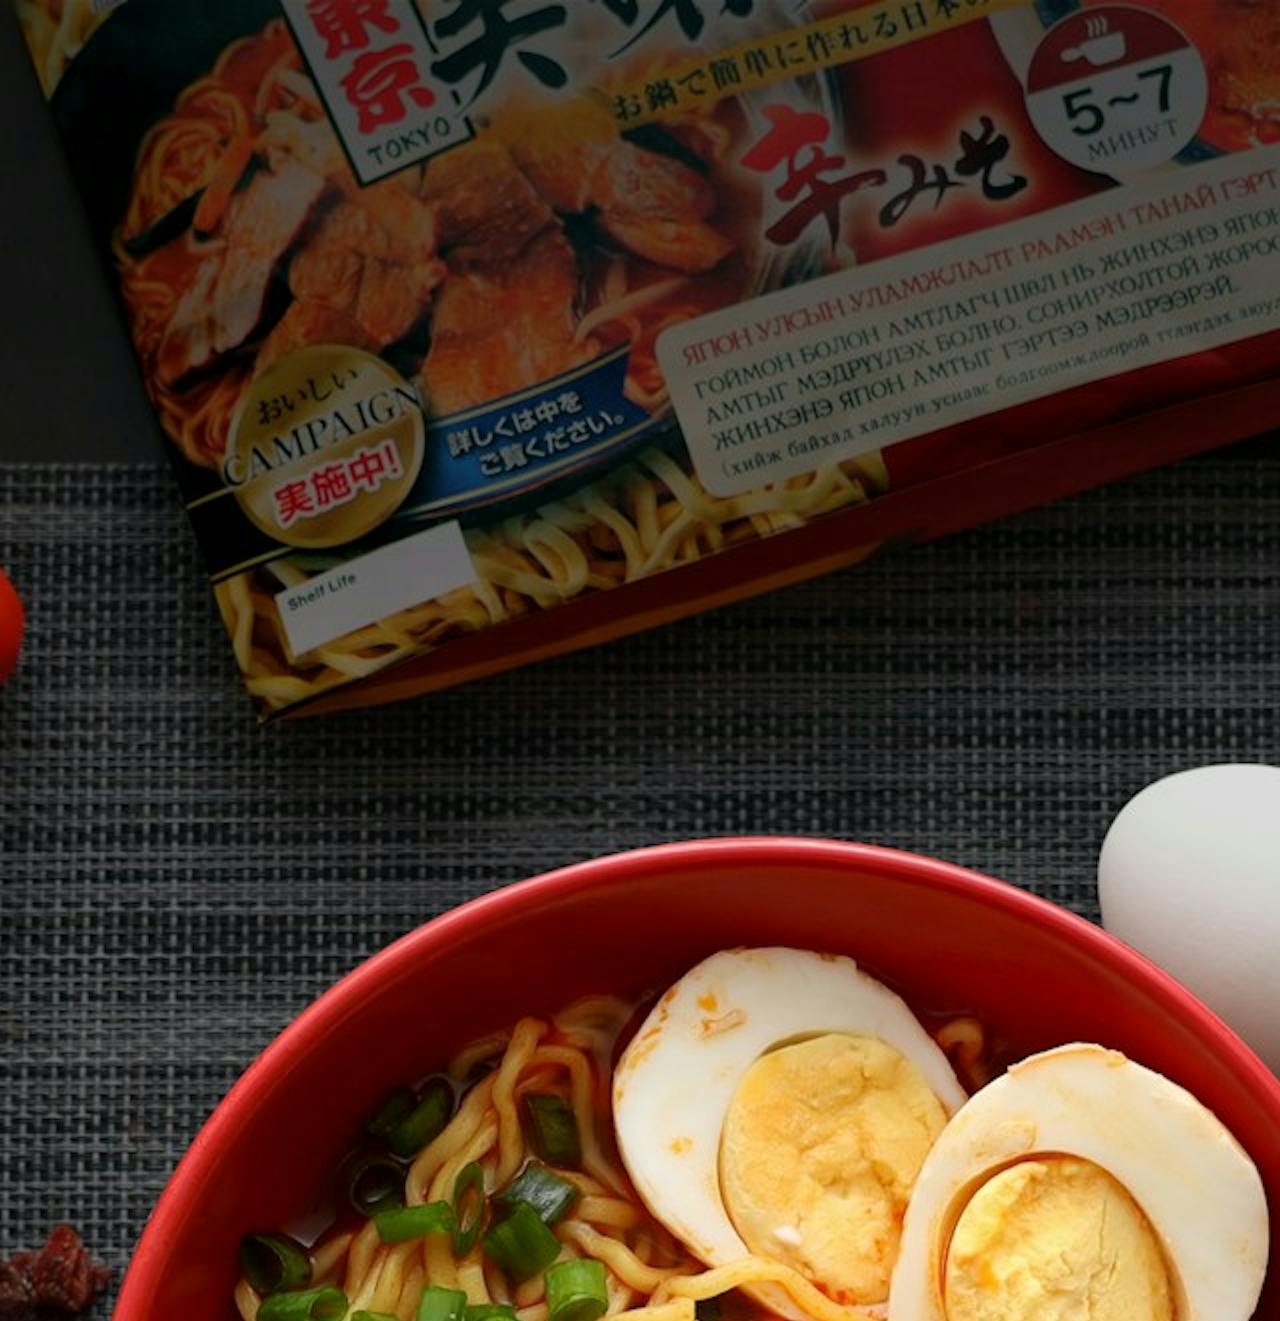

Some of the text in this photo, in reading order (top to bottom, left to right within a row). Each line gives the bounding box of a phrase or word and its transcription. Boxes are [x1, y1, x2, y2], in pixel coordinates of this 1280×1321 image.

[367, 118, 451, 165] TOKYO
[1087, 118, 1177, 161] МИНУТ
[740, 104, 1027, 252] 辛みそ
[682, 168, 1279, 366] ЯПОН УЛСЫН УЛАМЖЛАЛТ РААМЭН ТАНАЙ ГЭРТ
[694, 351, 797, 400] ГОЙМОН
[800, 326, 882, 363] БОЛОН
[889, 288, 1001, 338] АМТЛАГЧ
[1061, 261, 1096, 283] НЬ
[1099, 219, 1219, 275] ЖИНХЭНЭ
[705, 381, 790, 425] АМТЫГ
[936, 314, 1022, 351] БОЛНО.
[1027, 253, 1202, 325] СОНИРХОЛТОЙ
[258, 368, 358, 425] おいしい
[713, 398, 834, 451] ЖИНХЭНЭ
[838, 374, 906, 410] ЯПОН
[911, 346, 994, 389] АМТЫГ
[1002, 320, 1089, 361] ГЭРТЭЭ
[223, 386, 423, 487] CAMPAIGN
[446, 390, 584, 457] 詳しくは中を
[480, 410, 625, 476] ご覧ください。
[721, 451, 783, 478] (хийж
[787, 430, 855, 458] байхад
[859, 403, 927, 436] халуун
[287, 572, 357, 612] Shelf Life
